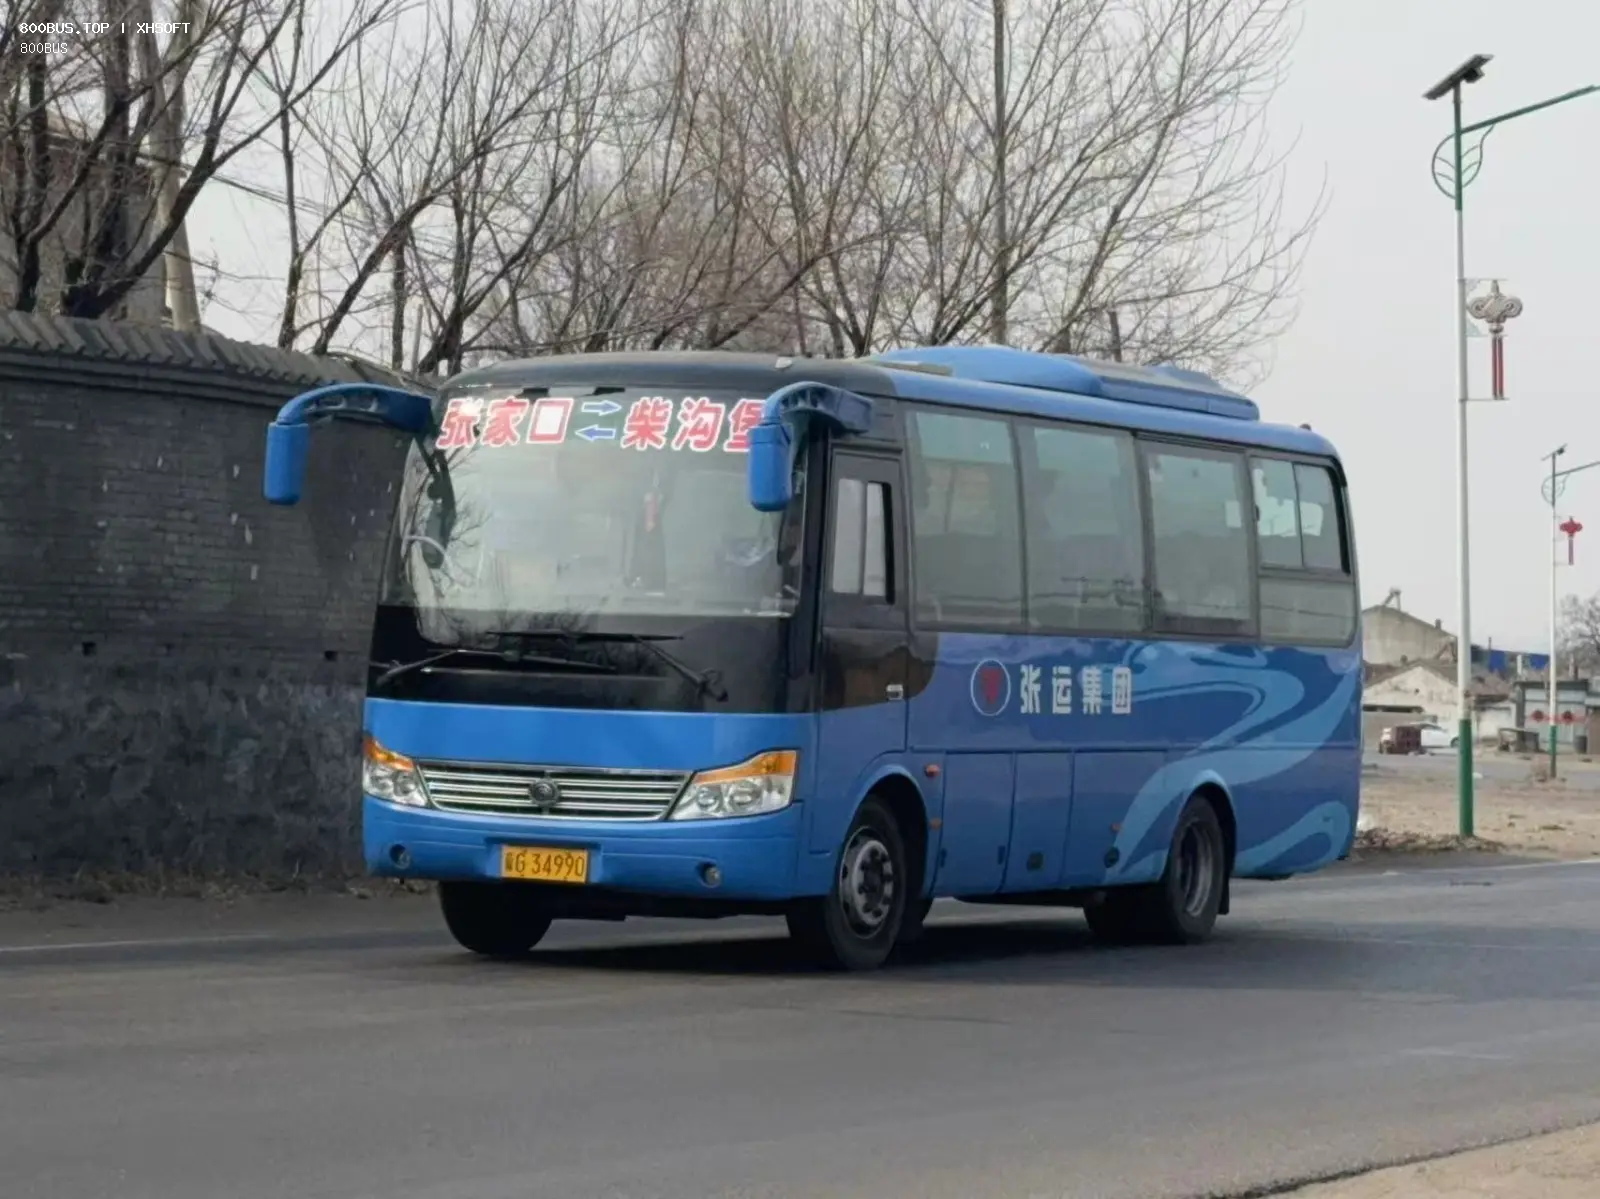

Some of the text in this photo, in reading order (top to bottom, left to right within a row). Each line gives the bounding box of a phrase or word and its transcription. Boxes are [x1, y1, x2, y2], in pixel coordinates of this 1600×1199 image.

[436, 396, 574, 450] 张家口
[1020, 664, 1132, 714] 张运集团
